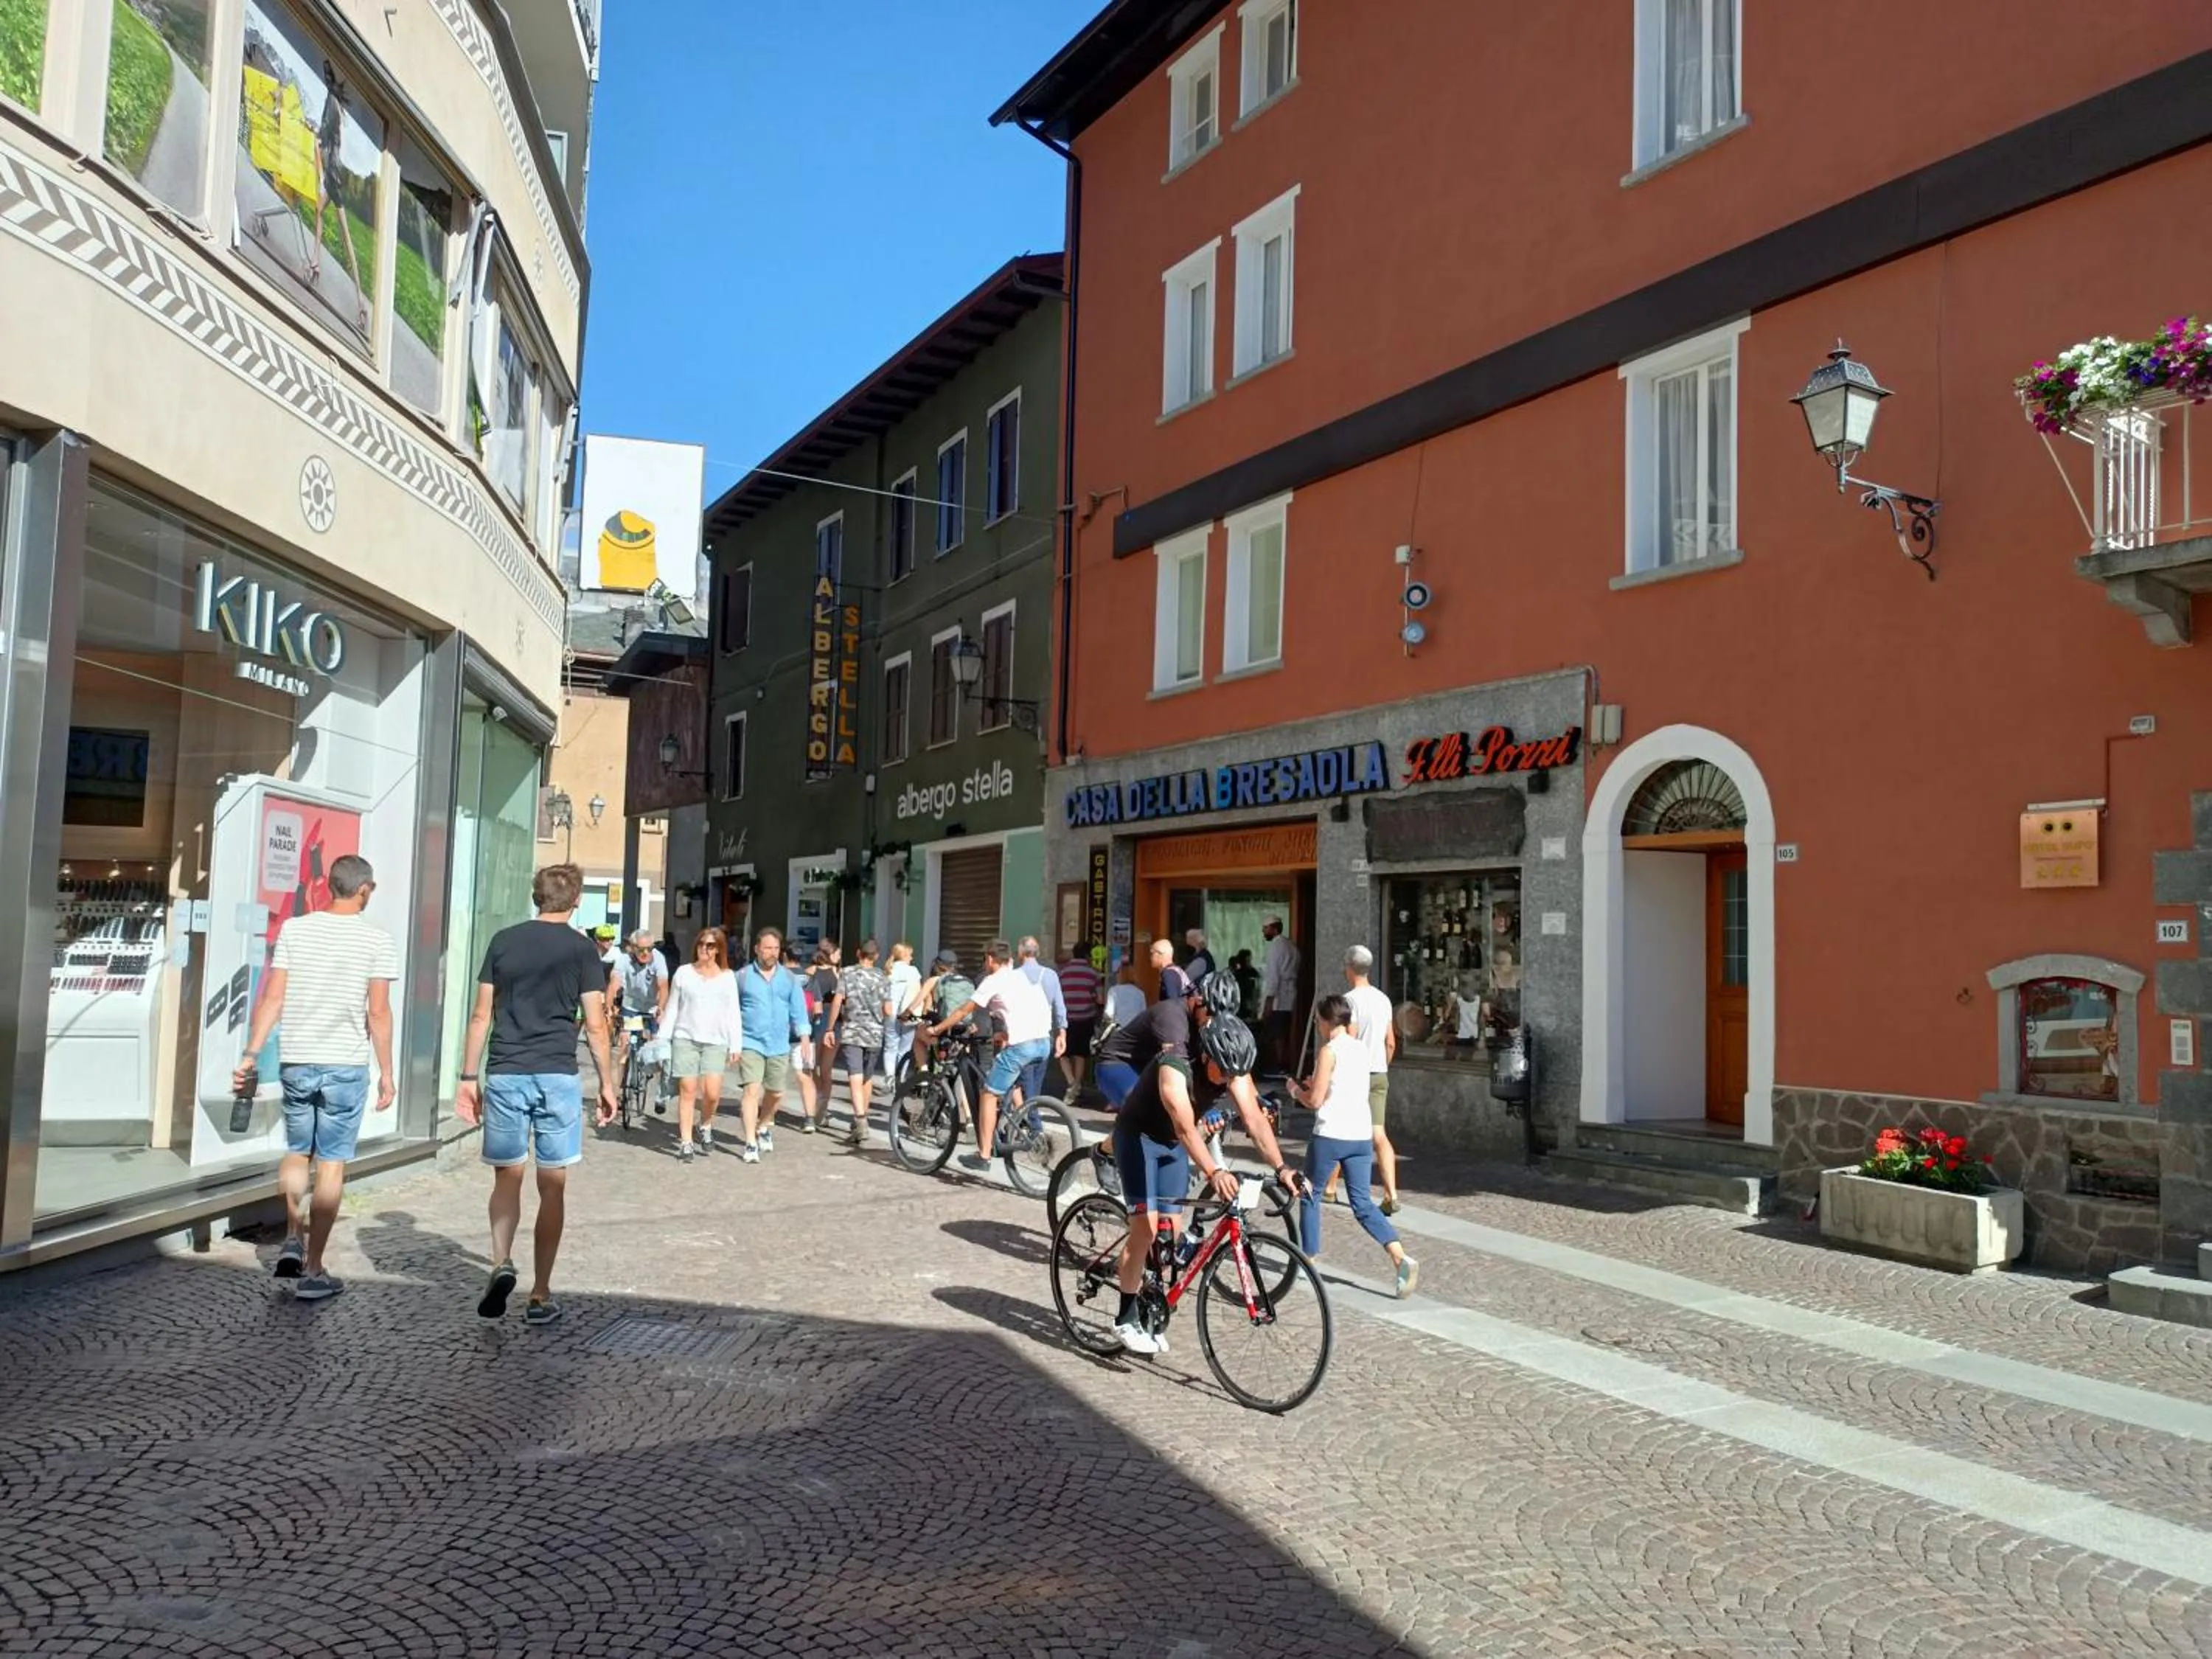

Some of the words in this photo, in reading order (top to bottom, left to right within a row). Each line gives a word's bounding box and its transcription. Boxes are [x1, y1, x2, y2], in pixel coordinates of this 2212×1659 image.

[195, 562, 344, 676] KIKO
[237, 662, 310, 696] MILANO
[809, 577, 833, 761] ALBERGO
[836, 604, 859, 764] STELLA
[897, 782, 956, 820] albergo
[962, 760, 1012, 804] stella
[1064, 782, 1120, 827] CASA
[1124, 769, 1207, 820] DELLA
[1215, 741, 1386, 808] BRESAOLA
[269, 837, 296, 852] PARADE
[275, 825, 292, 837] NAIL
[1779, 849, 1793, 858] 105
[2162, 925, 2183, 937] 107
